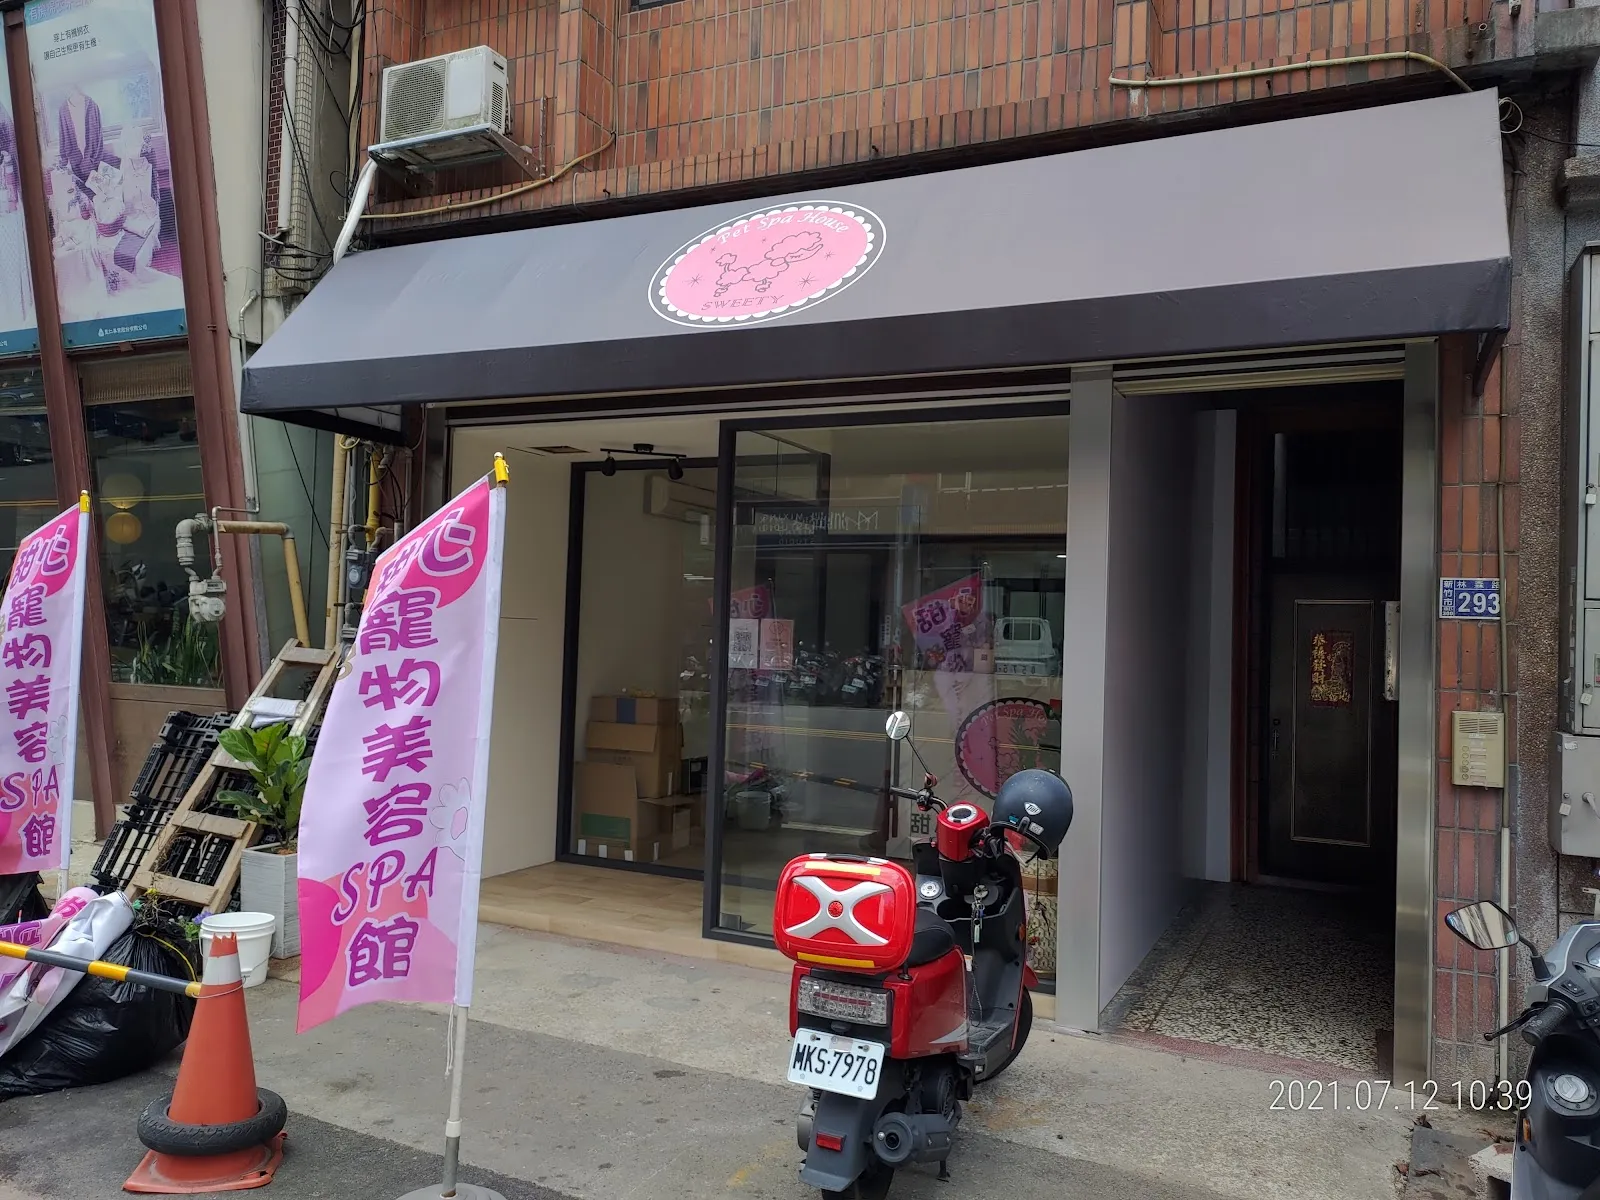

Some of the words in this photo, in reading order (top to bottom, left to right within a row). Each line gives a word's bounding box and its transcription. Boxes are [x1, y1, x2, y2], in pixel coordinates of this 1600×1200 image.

[717, 225, 750, 244] Pet
[757, 214, 794, 230] Spa
[797, 211, 850, 232] House
[701, 294, 785, 311] SWEETY
[1443, 581, 1454, 606] 新竹市
[1458, 592, 1501, 615] 293
